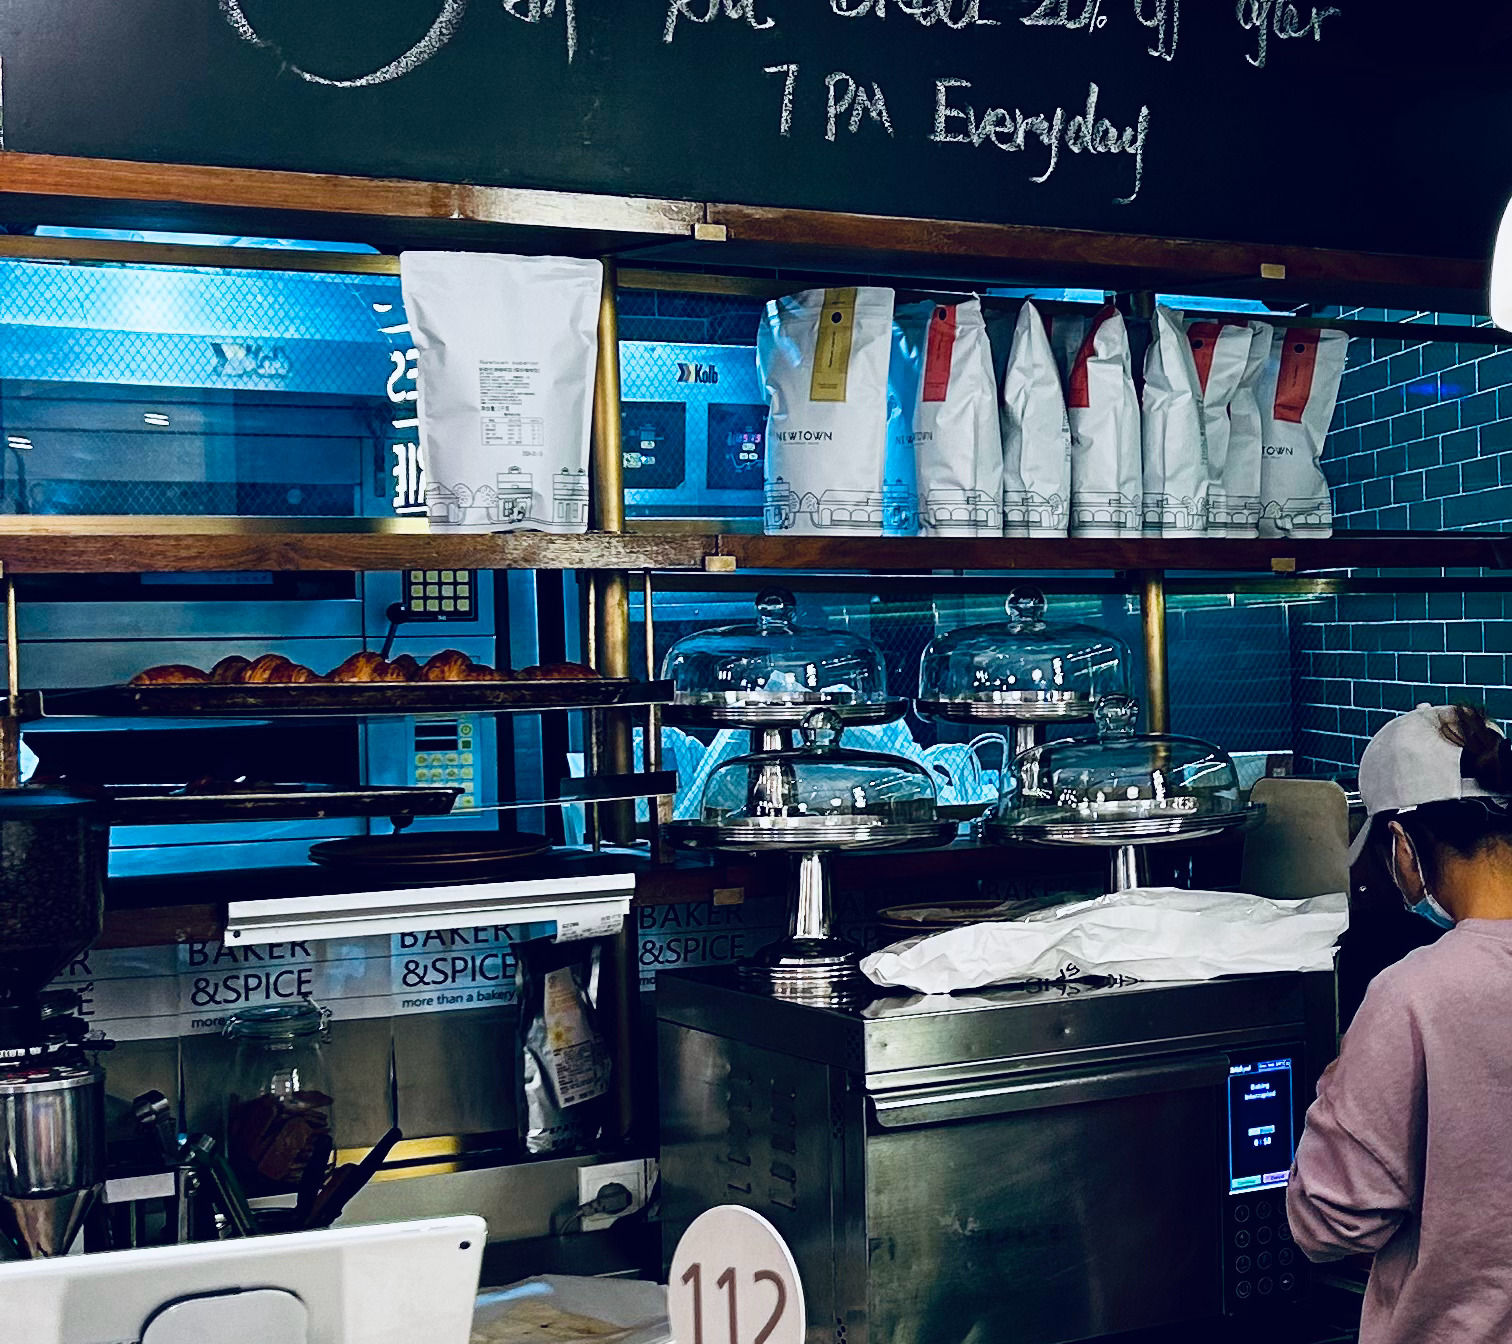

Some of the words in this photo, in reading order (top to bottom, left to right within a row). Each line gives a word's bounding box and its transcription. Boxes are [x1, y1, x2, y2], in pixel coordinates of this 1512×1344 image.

[764, 61, 800, 139] 7
[824, 70, 895, 144] PM
[930, 75, 1151, 205] Everyday
[694, 363, 719, 385] Kolb
[776, 430, 833, 442] NEWTOWN
[1261, 445, 1294, 456] TOWN
[638, 902, 745, 930] BAKER
[400, 923, 515, 949] BAKER
[639, 932, 746, 966] &SPICE
[187, 940, 312, 967] BAKER
[401, 952, 519, 988] &SPICE
[639, 976, 656, 987] mo
[190, 967, 314, 1007] &SPICE
[402, 996, 434, 1009] more
[436, 992, 464, 1006] than
[466, 994, 474, 1003] a
[476, 988, 517, 1004] bakery
[191, 1015, 226, 1029] more
